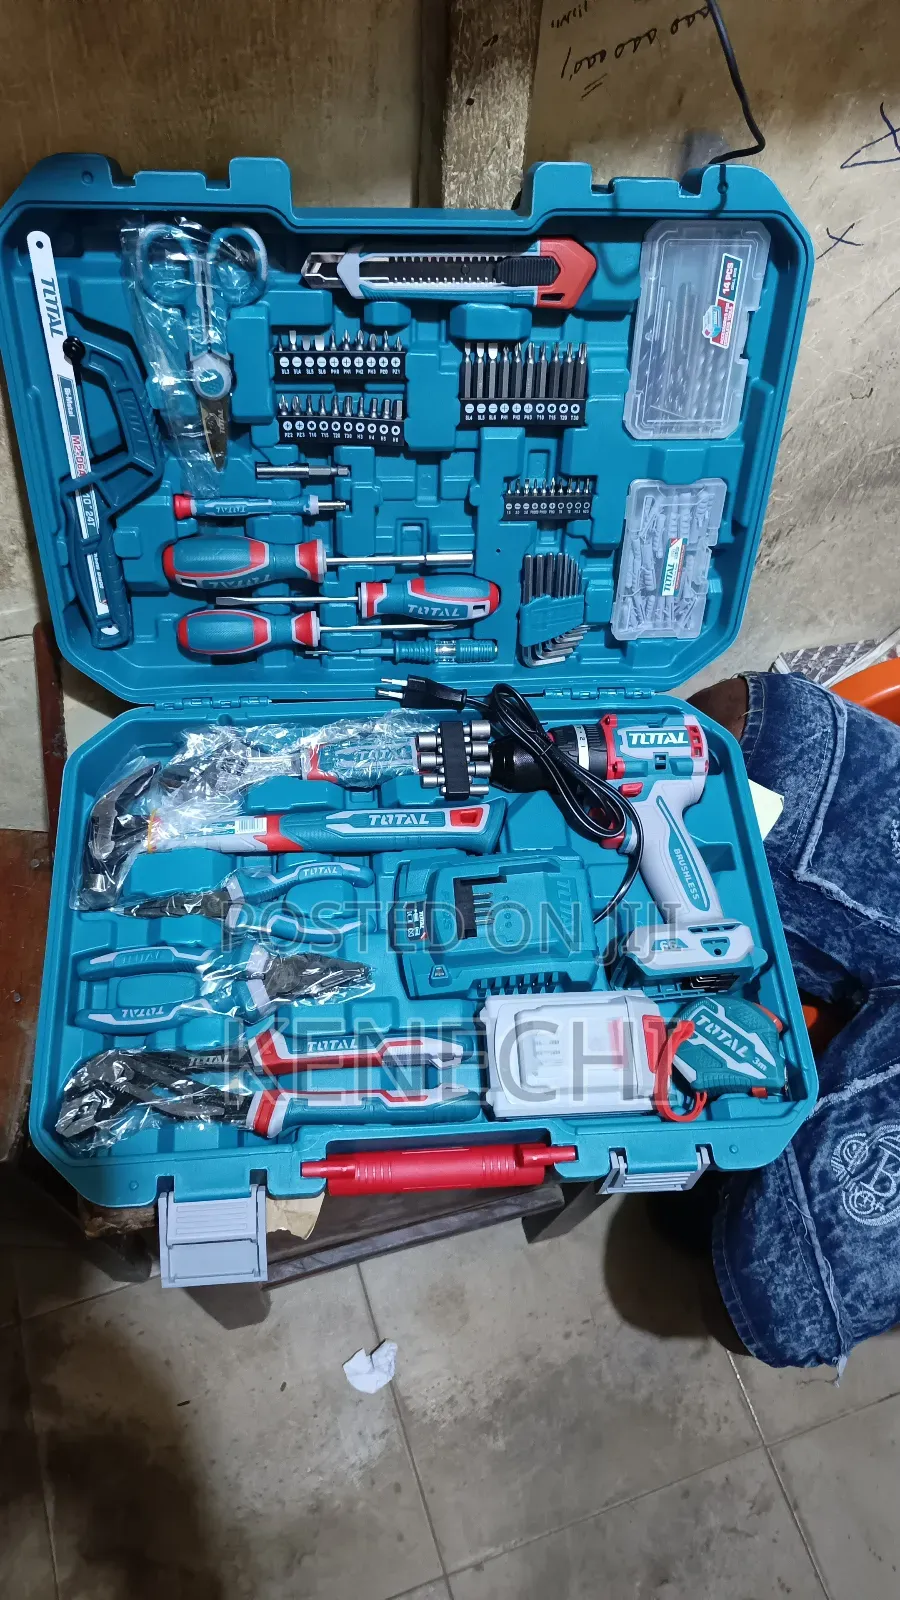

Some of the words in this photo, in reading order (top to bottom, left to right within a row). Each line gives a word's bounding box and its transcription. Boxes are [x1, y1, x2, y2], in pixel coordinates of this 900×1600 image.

[723, 262, 734, 281] PCS
[40, 276, 64, 338] TOTAL
[63, 387, 75, 417] Bi-Metal
[215, 504, 246, 514] TOTAL
[84, 510, 96, 528] 24T
[208, 574, 271, 589] TOTAL
[663, 562, 675, 592] TOTAL
[407, 604, 461, 617] TOTAL
[628, 731, 689, 746] TOTAL
[368, 813, 430, 826] TOTAL
[303, 866, 338, 877] TOTAL
[673, 848, 700, 901] BRUSHLESS
[121, 1007, 164, 1019] TOTAL
[696, 1014, 750, 1058] TOTAL
[306, 1040, 360, 1052] TOTAL
[188, 1055, 230, 1067] TOTAL
[751, 1056, 767, 1071] 3m
